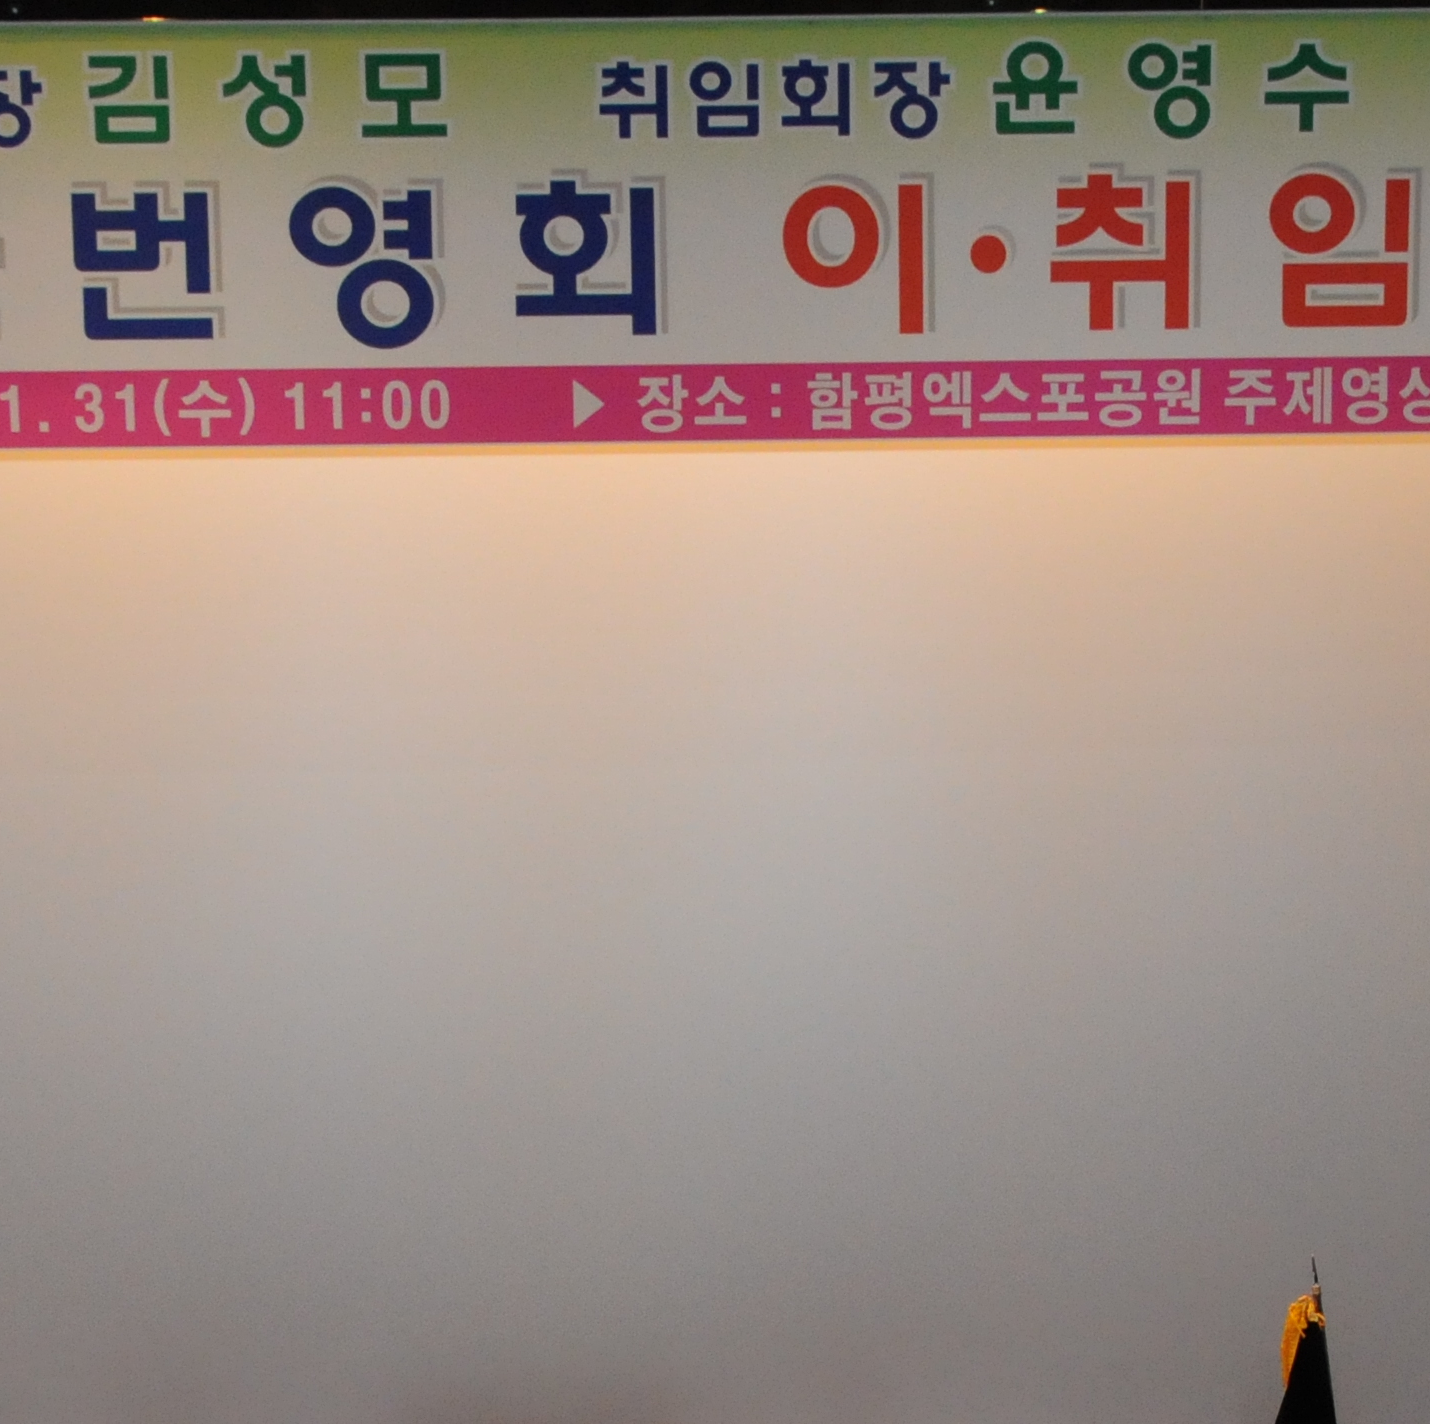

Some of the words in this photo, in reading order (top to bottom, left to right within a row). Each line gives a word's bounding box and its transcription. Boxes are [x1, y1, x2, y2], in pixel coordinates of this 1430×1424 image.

[87, 52, 449, 147] 김성모
[599, 58, 952, 138] 취임회장
[992, 40, 1351, 139] 윤영수
[284, 379, 450, 430] 11:00
[806, 367, 1202, 431] 함평엑스포공원
